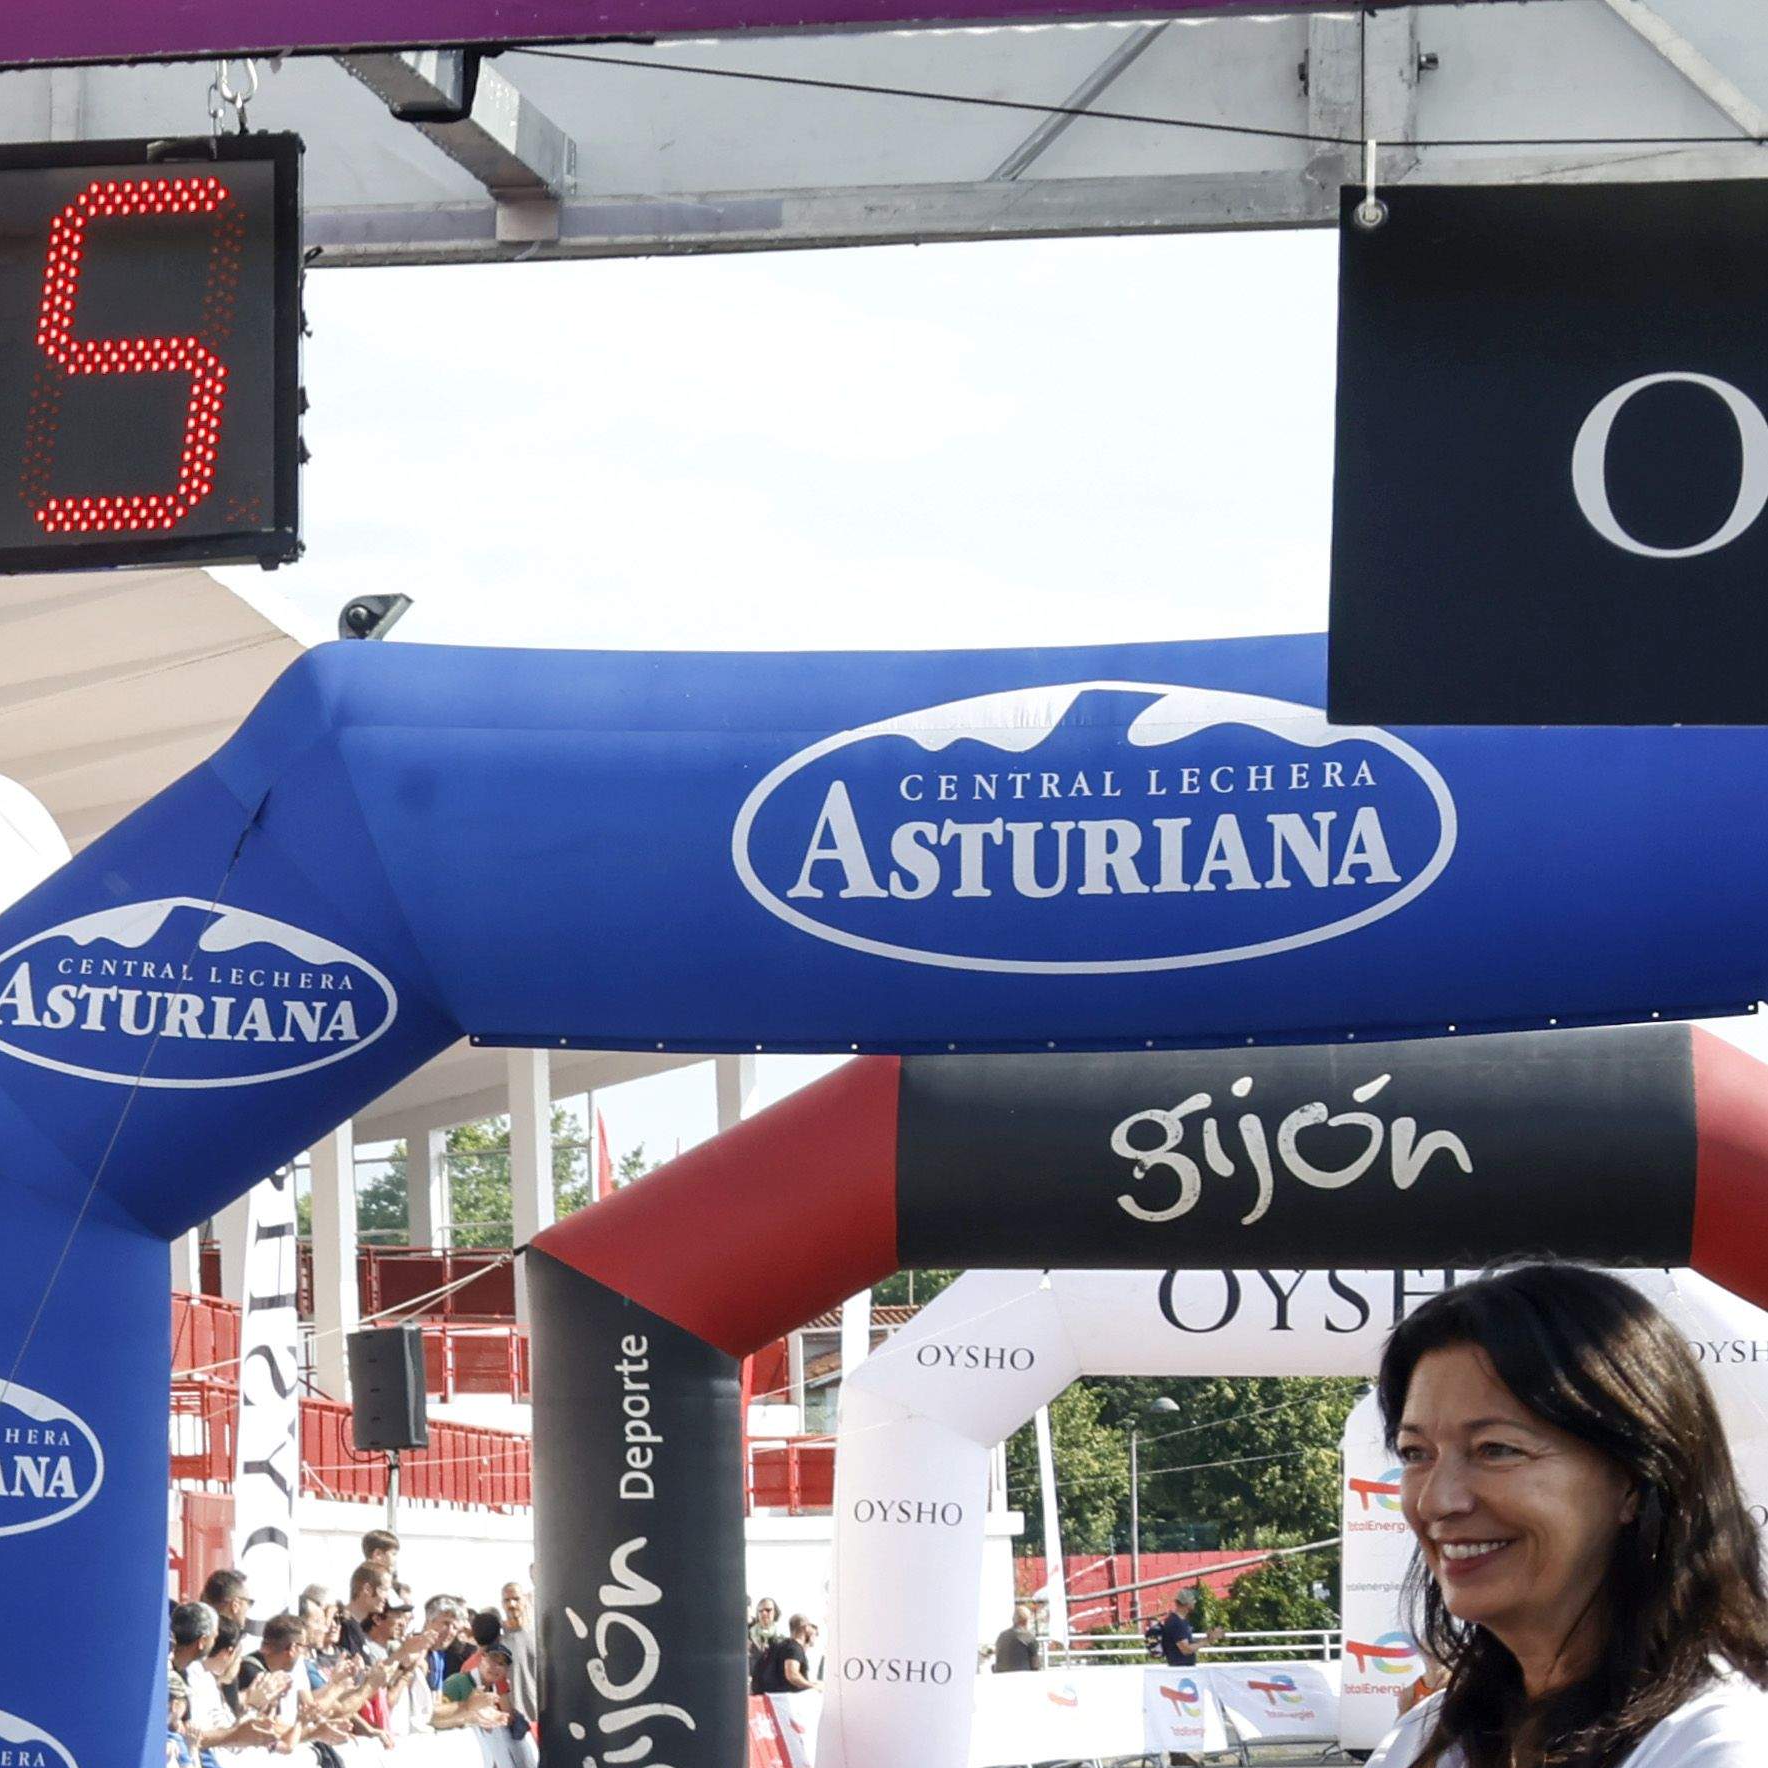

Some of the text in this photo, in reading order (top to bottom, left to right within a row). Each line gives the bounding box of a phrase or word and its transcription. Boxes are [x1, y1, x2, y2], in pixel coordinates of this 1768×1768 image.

[899, 760, 1377, 801] CENTRAL LECHERA
[786, 779, 1403, 900] ASTURIANA
[58, 957, 355, 991] CENTRAL LECHERA
[1110, 1073, 1473, 1226] gijón
[1158, 1269, 1455, 1333] OYSH
[916, 1344, 1035, 1371] OYSHO
[615, 1333, 664, 1500] Deporte
[854, 1500, 962, 1526] OYSHO
[844, 1657, 952, 1685] OYSHO
